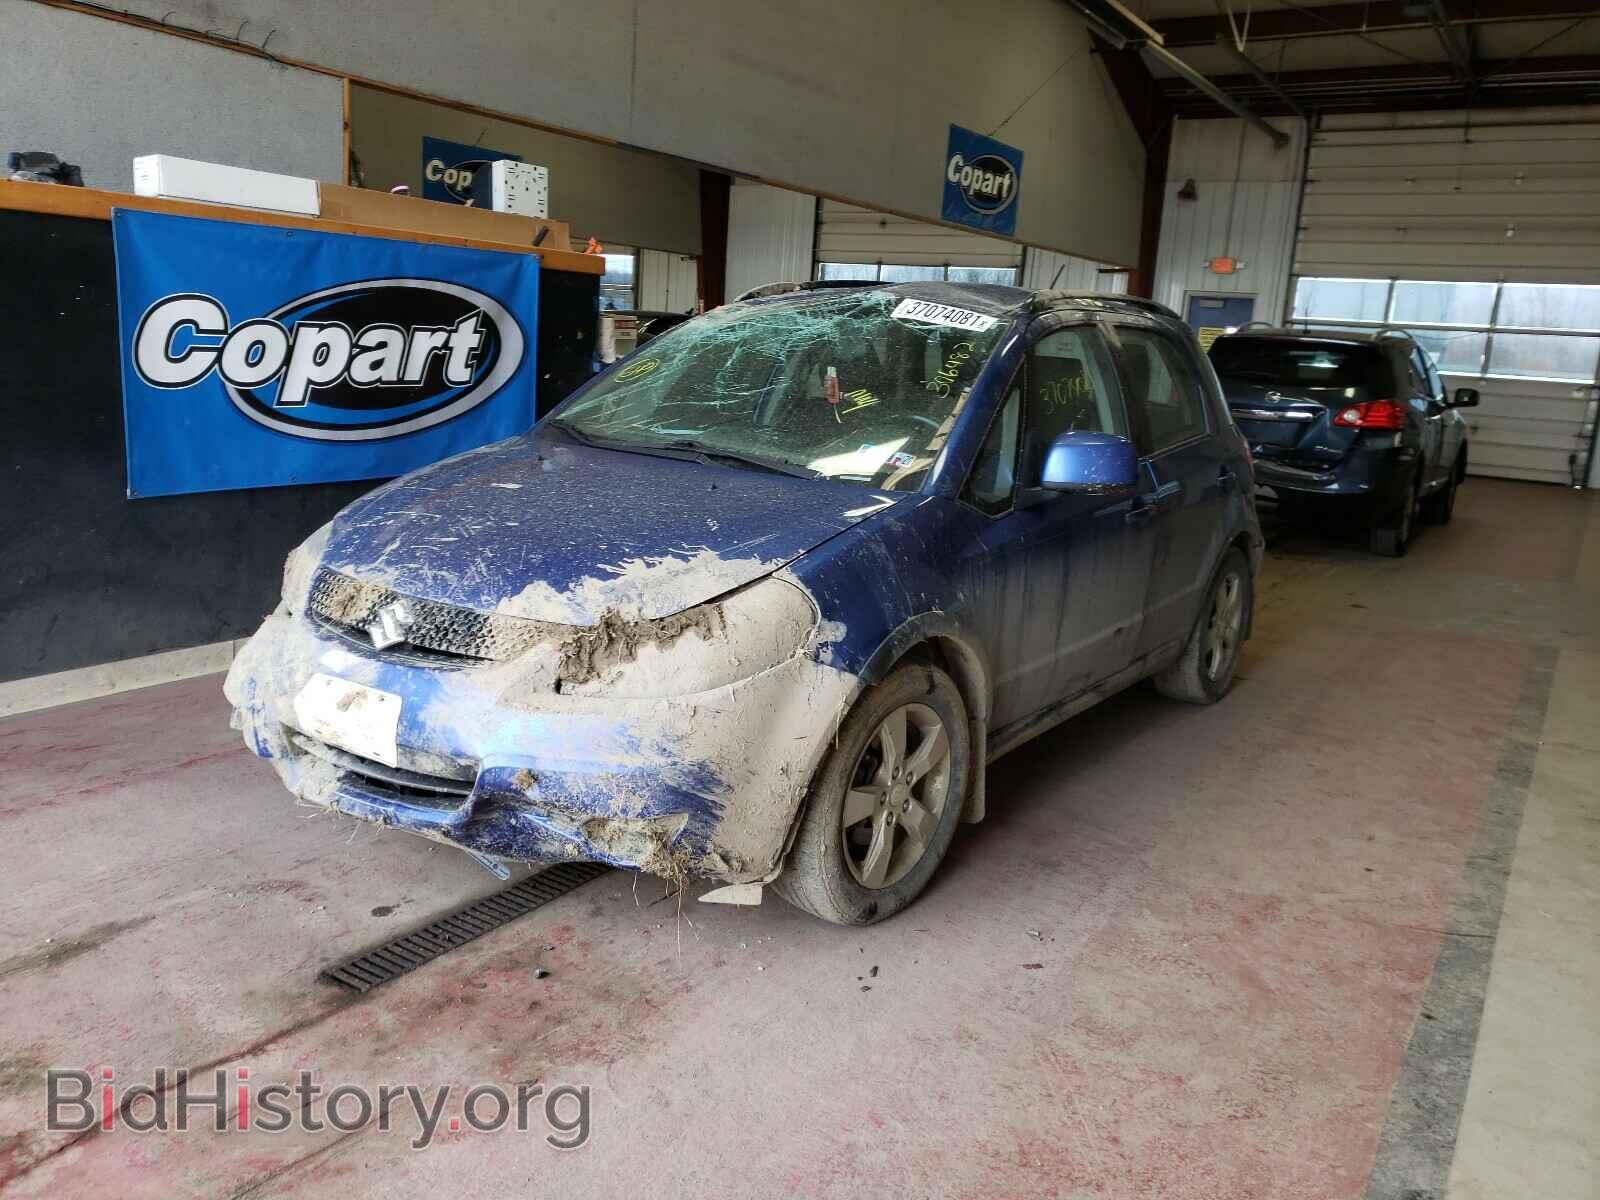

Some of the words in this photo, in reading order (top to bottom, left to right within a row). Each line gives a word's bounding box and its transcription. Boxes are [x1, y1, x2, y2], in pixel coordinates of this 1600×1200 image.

[425, 158, 473, 192] Cop
[947, 152, 1012, 198] Copart
[906, 301, 983, 327] 37074081
[132, 293, 487, 407] Copart
